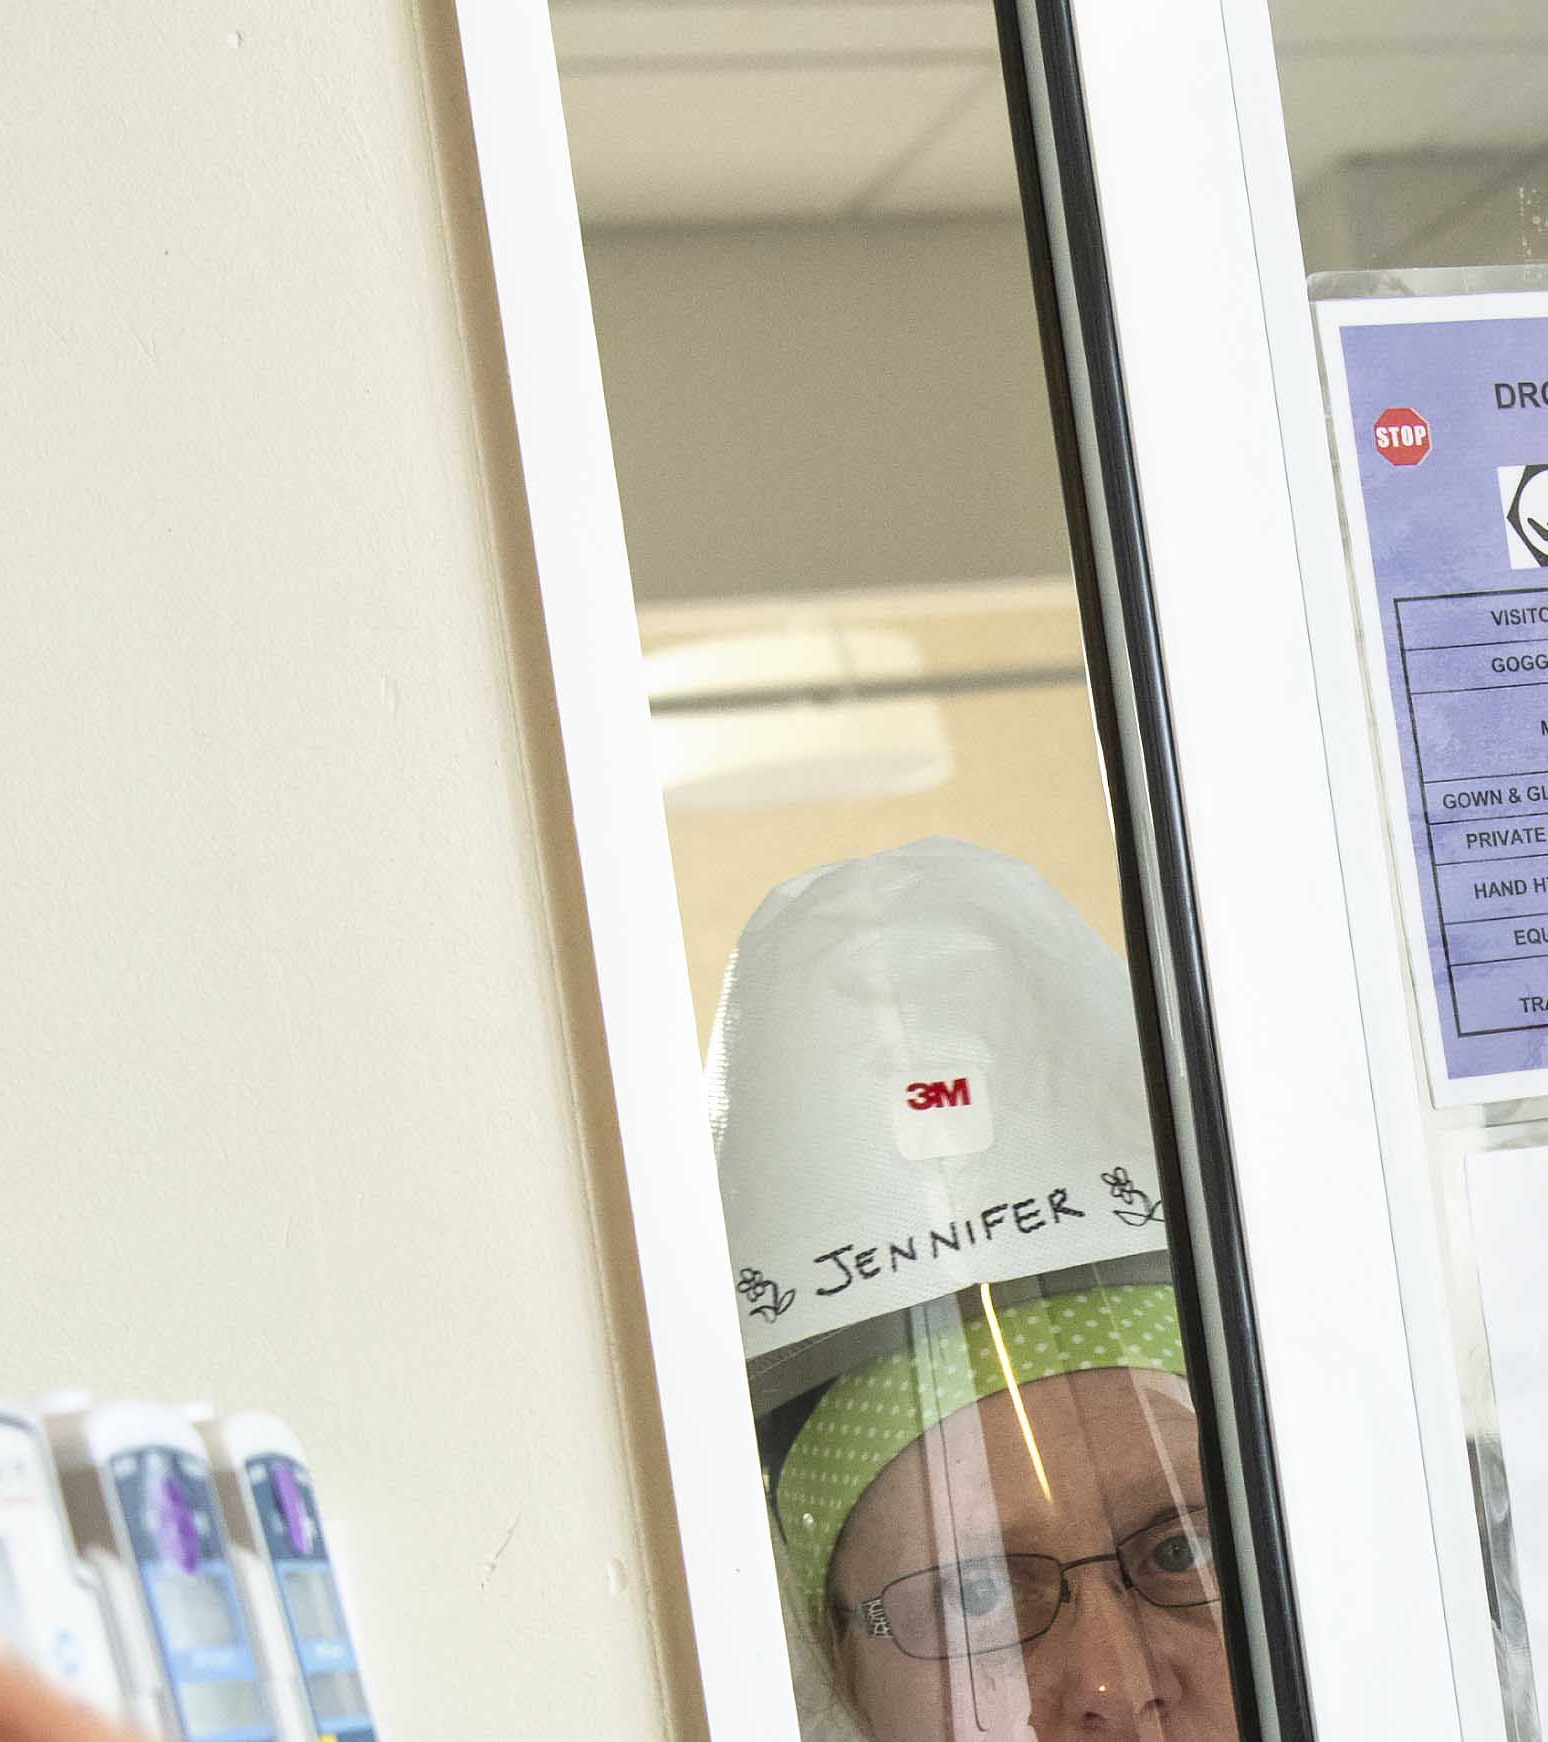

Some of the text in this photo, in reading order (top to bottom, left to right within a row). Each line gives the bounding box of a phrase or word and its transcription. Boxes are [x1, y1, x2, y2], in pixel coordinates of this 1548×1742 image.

[1376, 424, 1428, 449] STOP
[1442, 788, 1503, 810] GOWN
[1508, 787, 1523, 804] &
[1465, 826, 1547, 850] PRIVATE
[1473, 879, 1528, 900] HAND
[906, 1078, 972, 1111] 3M
[815, 1187, 1086, 1298] JENNIFER
